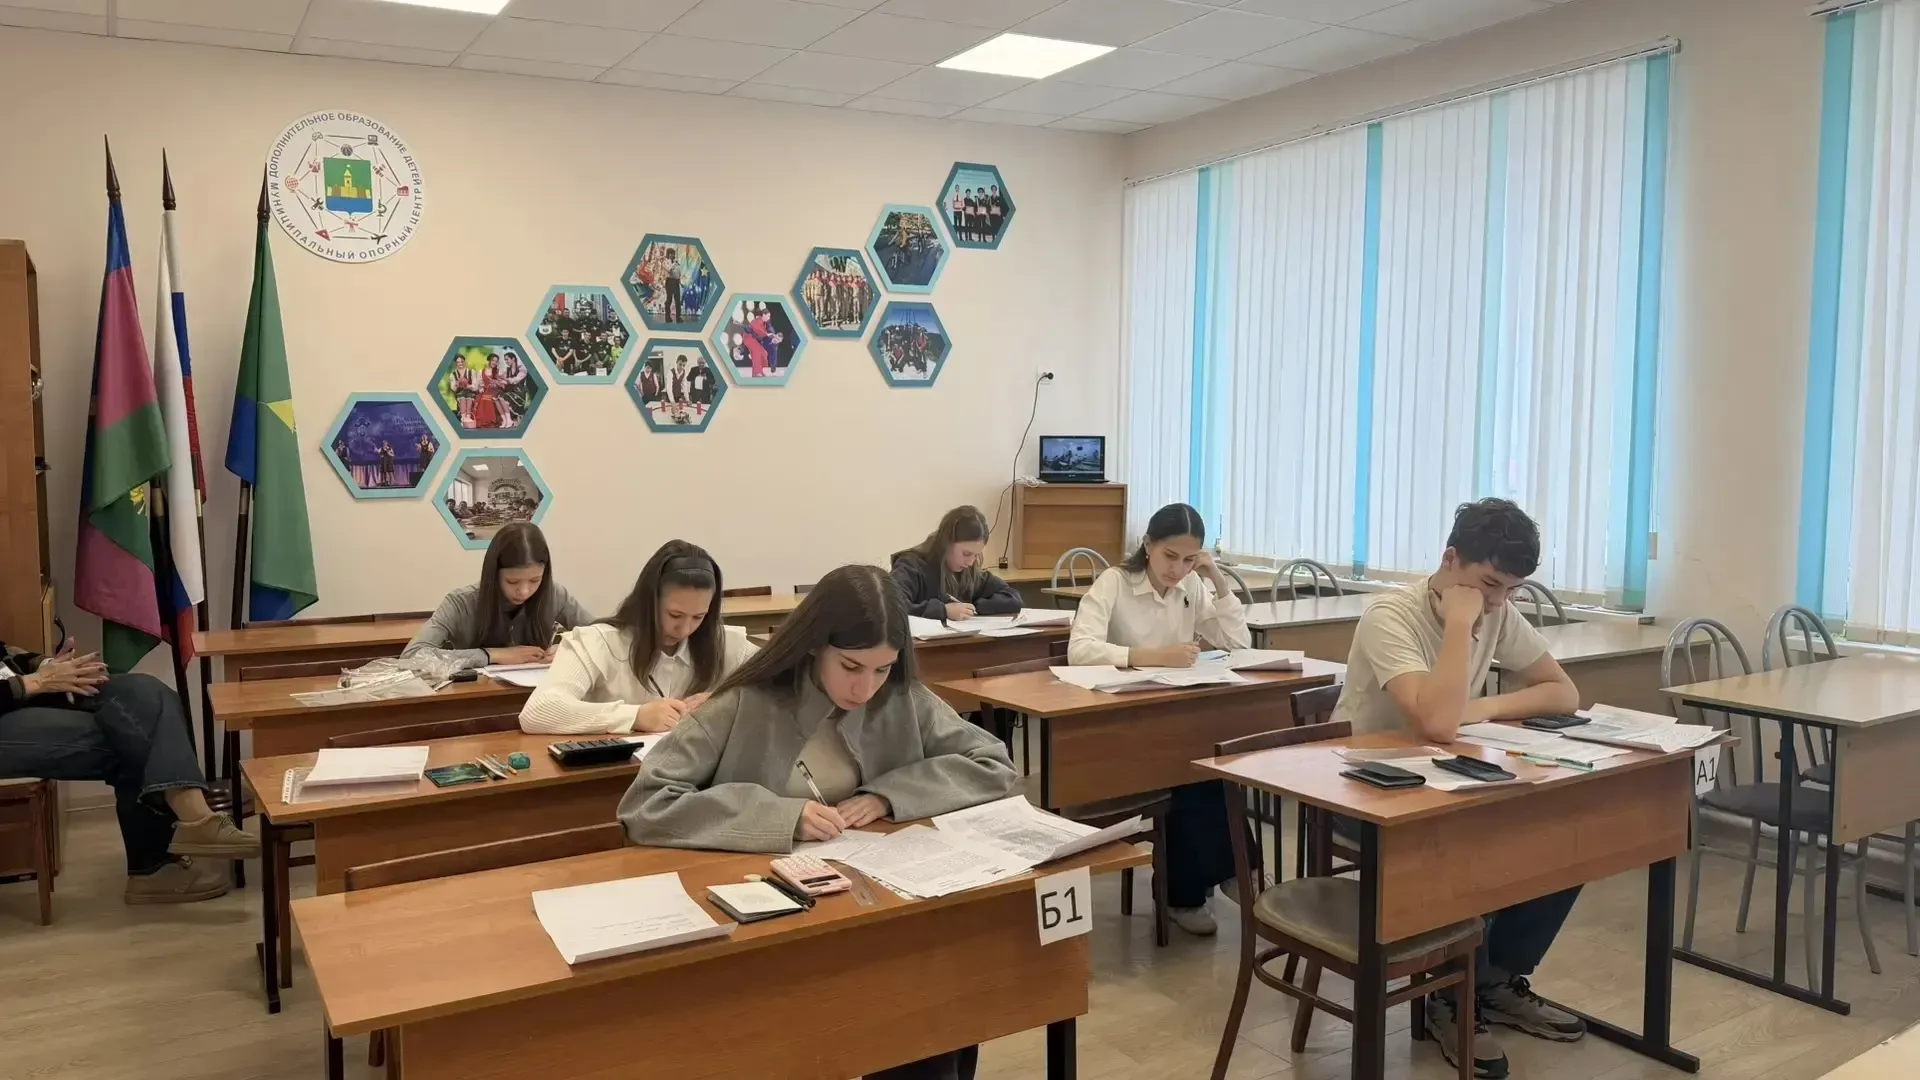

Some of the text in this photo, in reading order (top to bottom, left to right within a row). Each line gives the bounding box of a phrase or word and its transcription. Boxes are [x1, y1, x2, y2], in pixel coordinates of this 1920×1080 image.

[269, 112, 423, 186] ДОПОЛНИТЕЛЬНОЕ ОБРАЗОВАНИЕ ДЕТЕЙ
[270, 182, 423, 260] МУНИЦИПАЛЬНЫЙ ОПОРНЫЙ ЦЕНТР
[1696, 756, 1715, 785] А1
[1040, 886, 1083, 930] Б1
